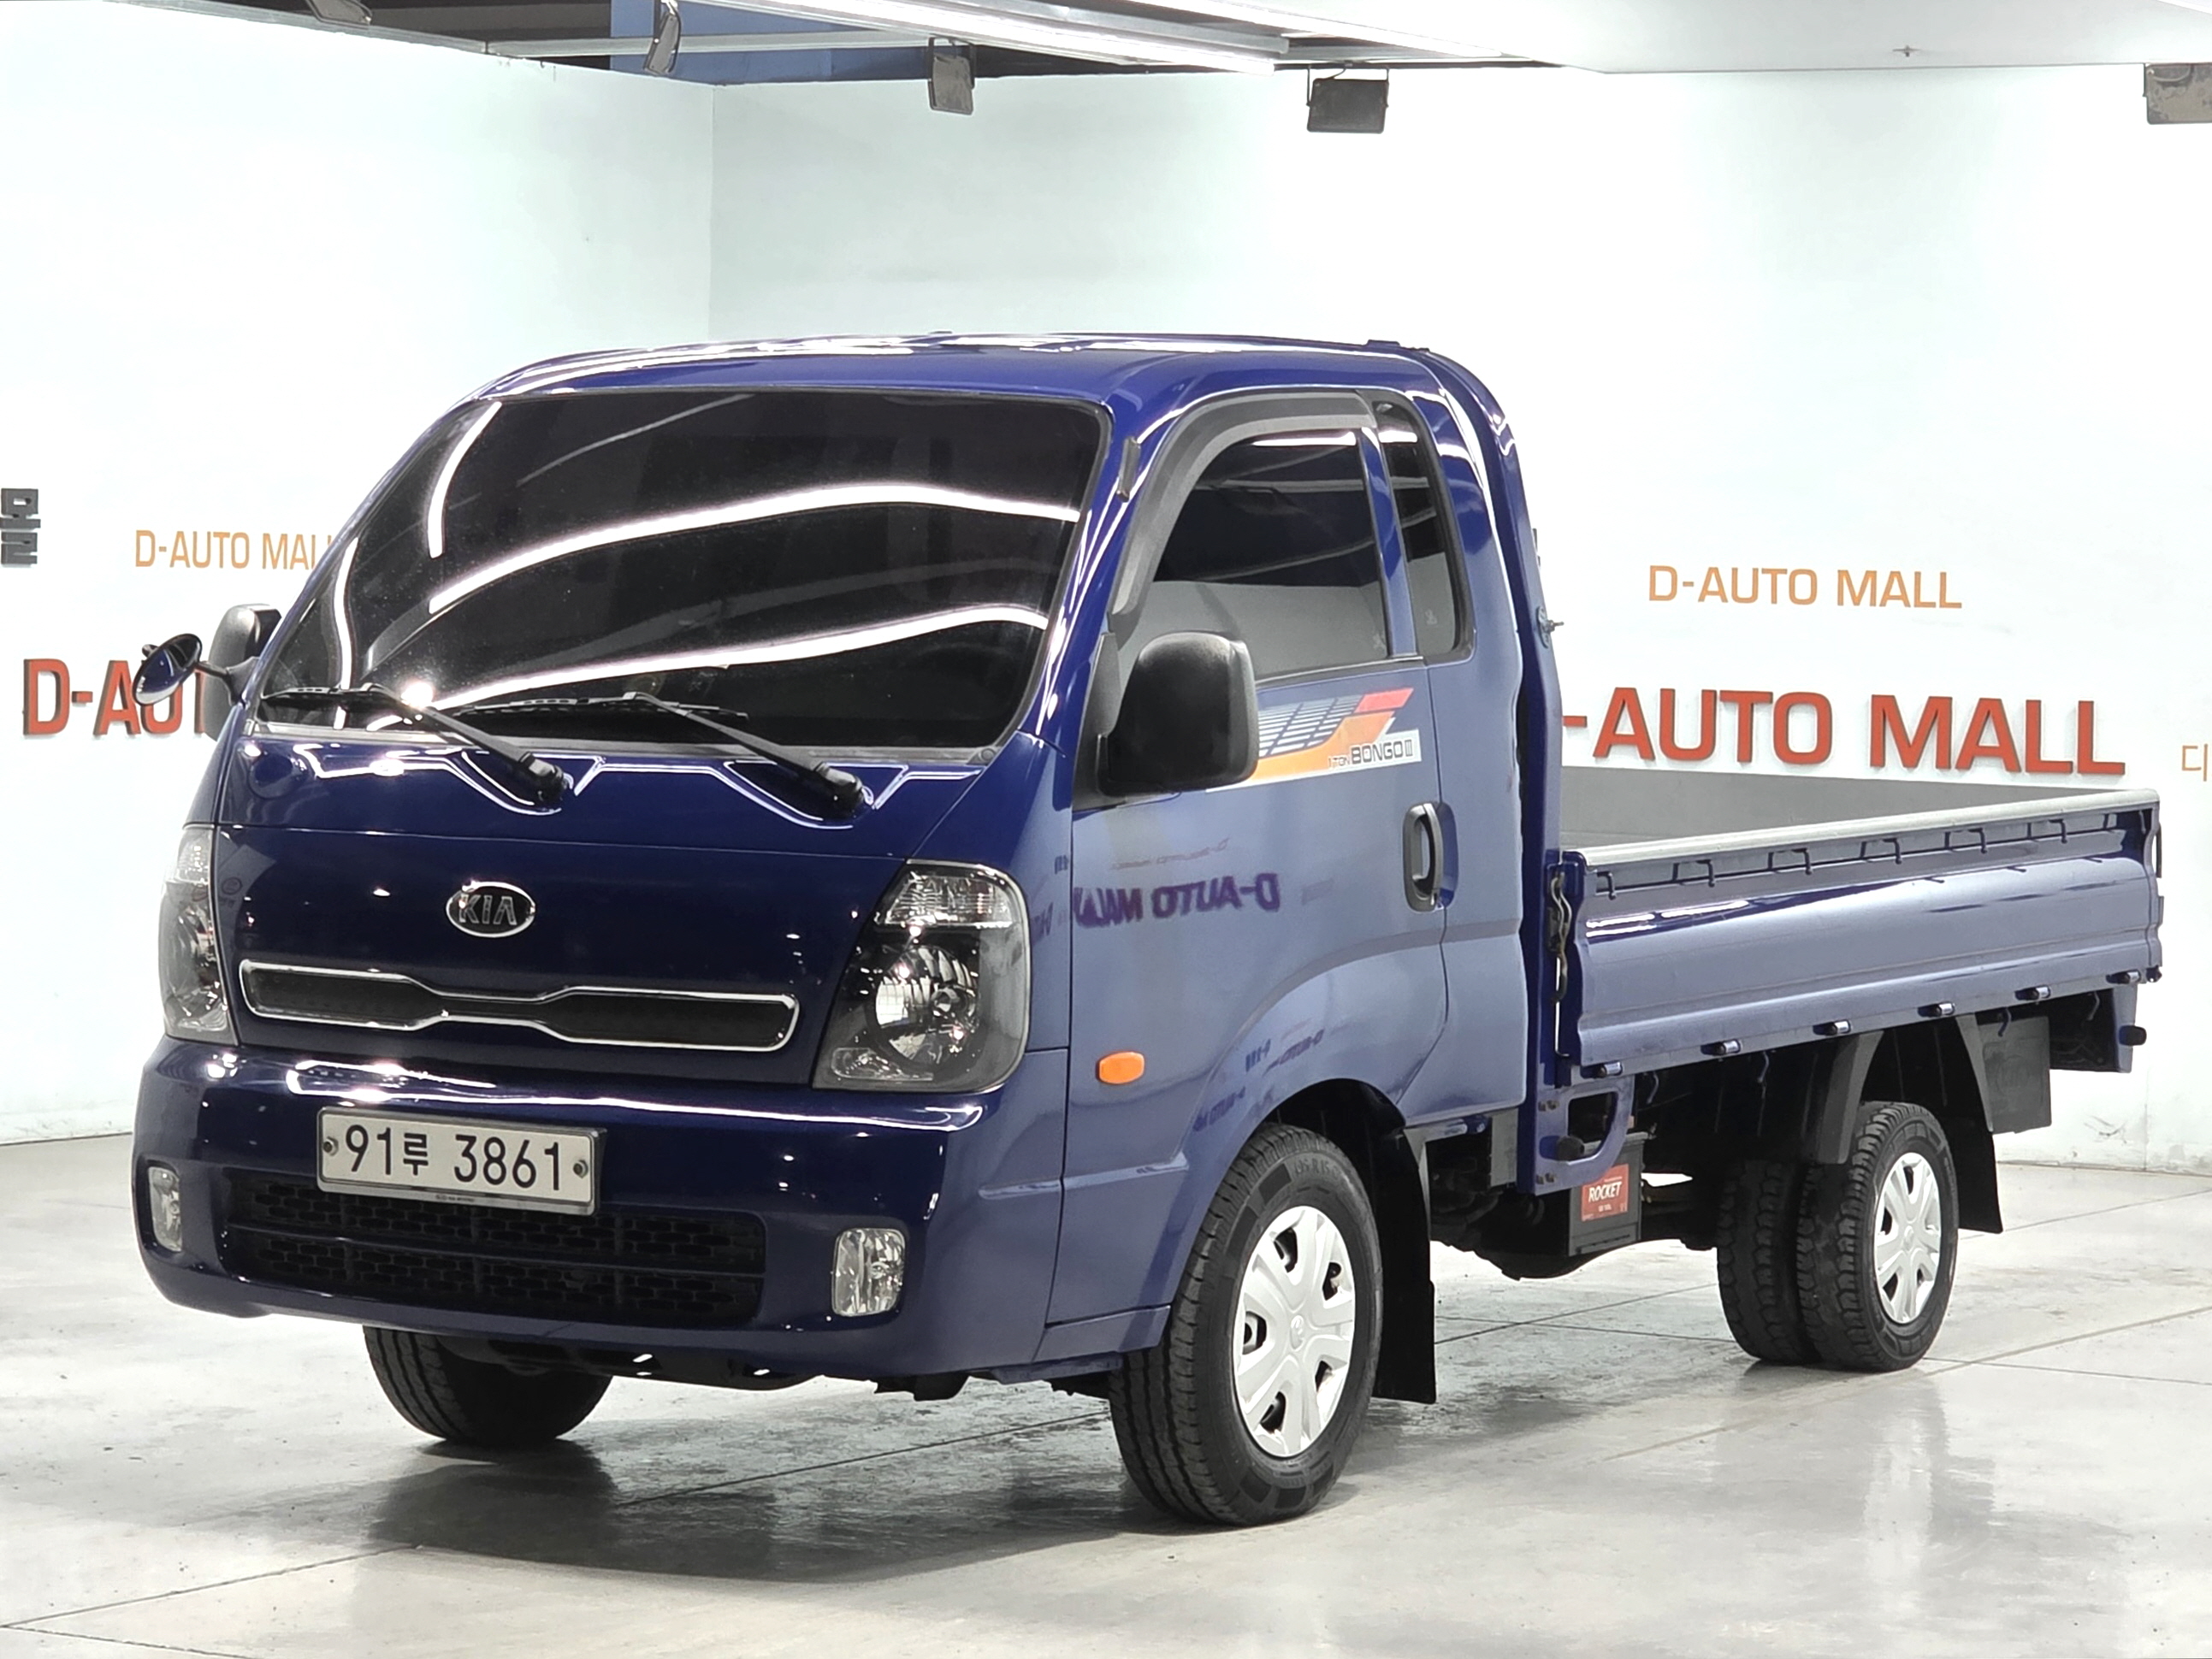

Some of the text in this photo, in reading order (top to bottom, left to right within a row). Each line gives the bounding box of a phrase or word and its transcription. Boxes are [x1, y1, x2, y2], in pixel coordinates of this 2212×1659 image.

[135, 530, 332, 570] D-AUTO MAL
[1649, 565, 1962, 609] D-AUTO MALL
[1870, 694, 2126, 776] MALL
[458, 895, 518, 925] KIA
[346, 1125, 560, 1191] 91루 3861
[1588, 1181, 1623, 1202] ROCKET
